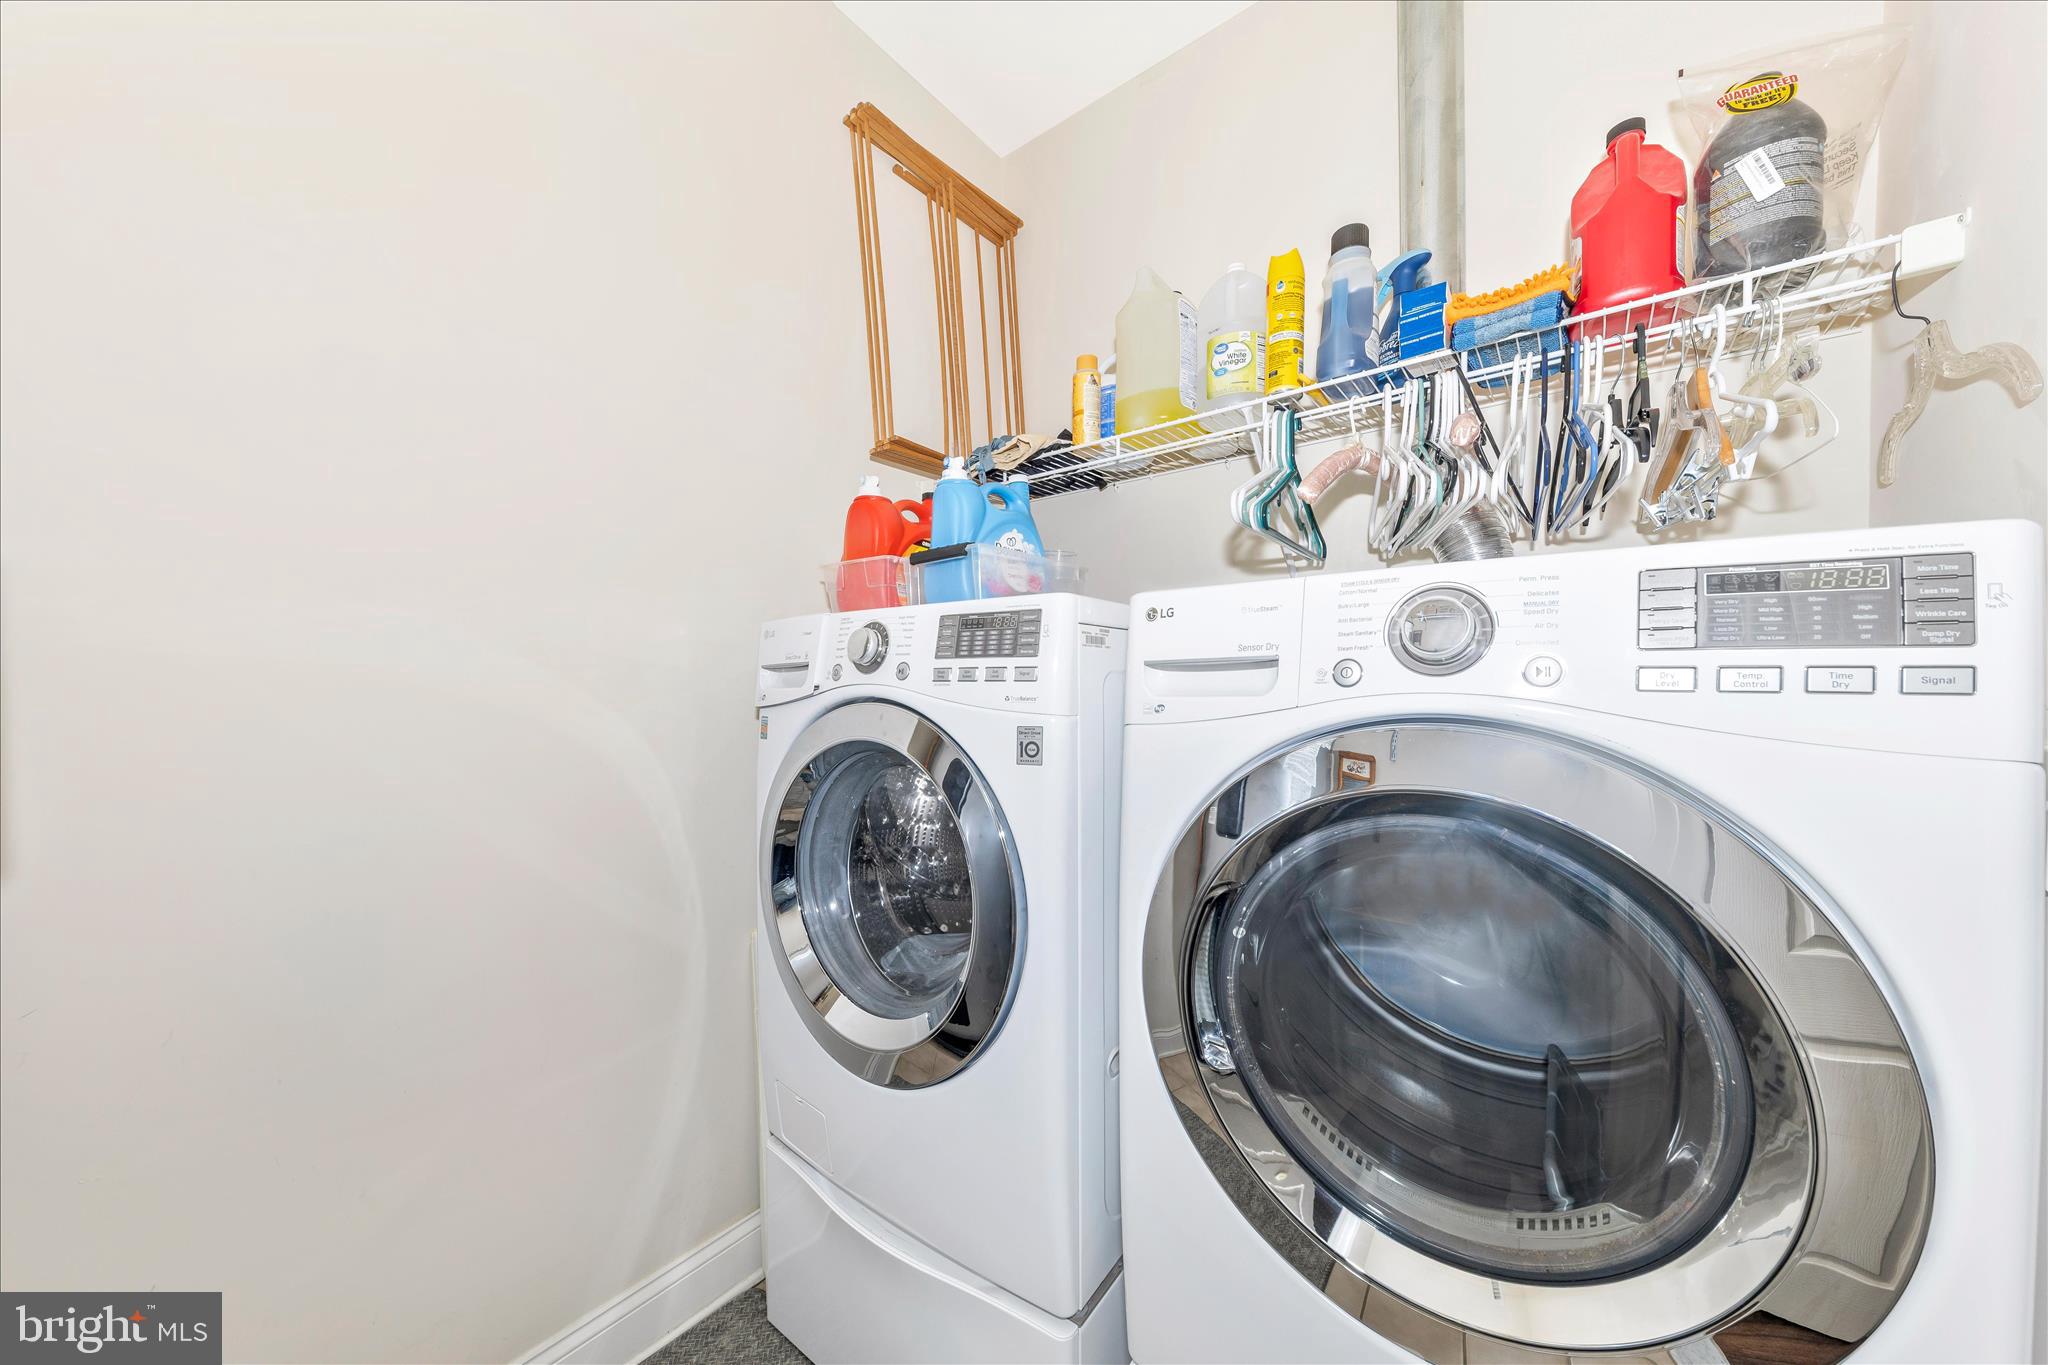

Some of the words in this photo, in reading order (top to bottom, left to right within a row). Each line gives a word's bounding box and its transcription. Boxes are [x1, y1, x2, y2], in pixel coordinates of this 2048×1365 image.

[1716, 74, 1799, 108] GUARANTEED
[1742, 92, 1783, 109] FREE!
[1226, 352, 1248, 360] White
[1218, 358, 1248, 367] Vinegar
[1940, 586, 1960, 594] Time
[1160, 607, 1175, 619] LG
[1947, 609, 1967, 617] Care
[1921, 630, 1945, 638] Damp
[1945, 629, 1961, 638] Dry
[1237, 643, 1264, 652] Sensor
[1265, 642, 1280, 653] Dry
[1659, 671, 1675, 681] Dry
[1828, 671, 1854, 680] Time
[1655, 680, 1680, 688] Level
[1733, 680, 1769, 688] Control
[1831, 680, 1850, 690] Dry
[1920, 676, 1957, 686] Signal
[1019, 740, 1040, 758] 10
